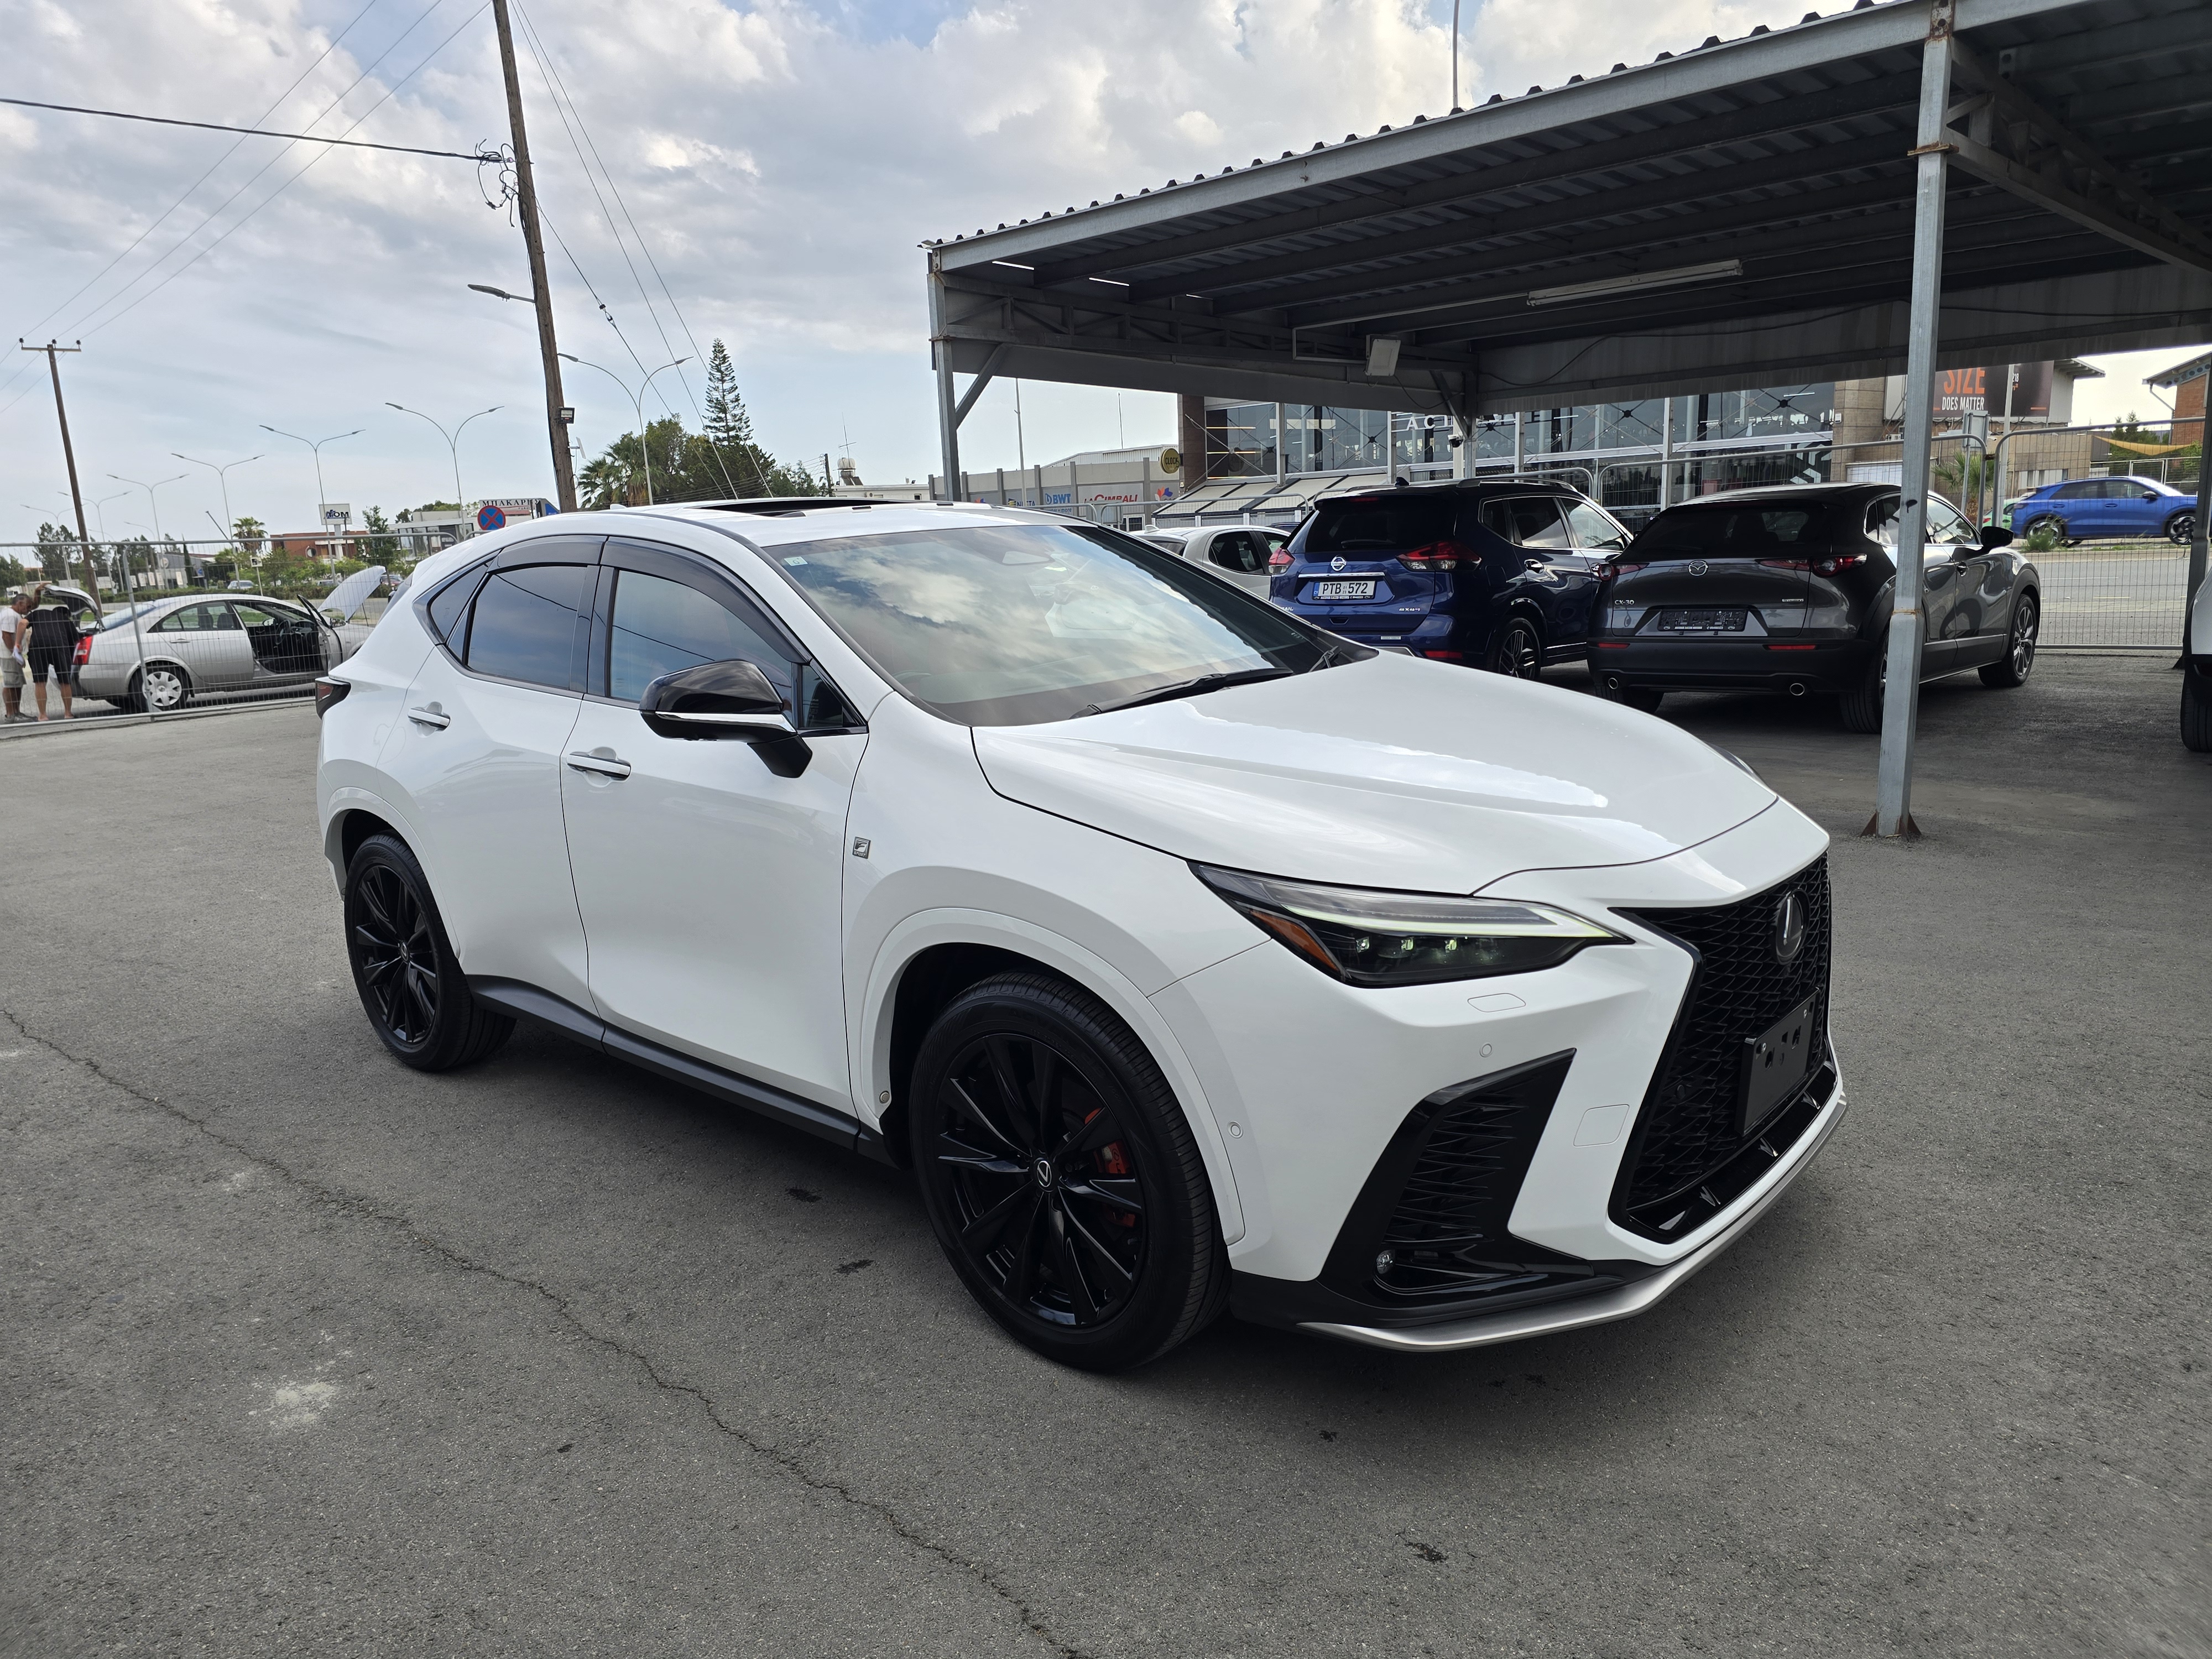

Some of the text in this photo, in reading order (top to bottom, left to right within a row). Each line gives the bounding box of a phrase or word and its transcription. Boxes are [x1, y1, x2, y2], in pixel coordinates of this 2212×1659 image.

[1943, 367, 1985, 394] SIZE
[1942, 397, 1985, 411] DOES MATTER
[1052, 493, 1071, 504] BWT
[1322, 582, 1368, 594] PTB 572
